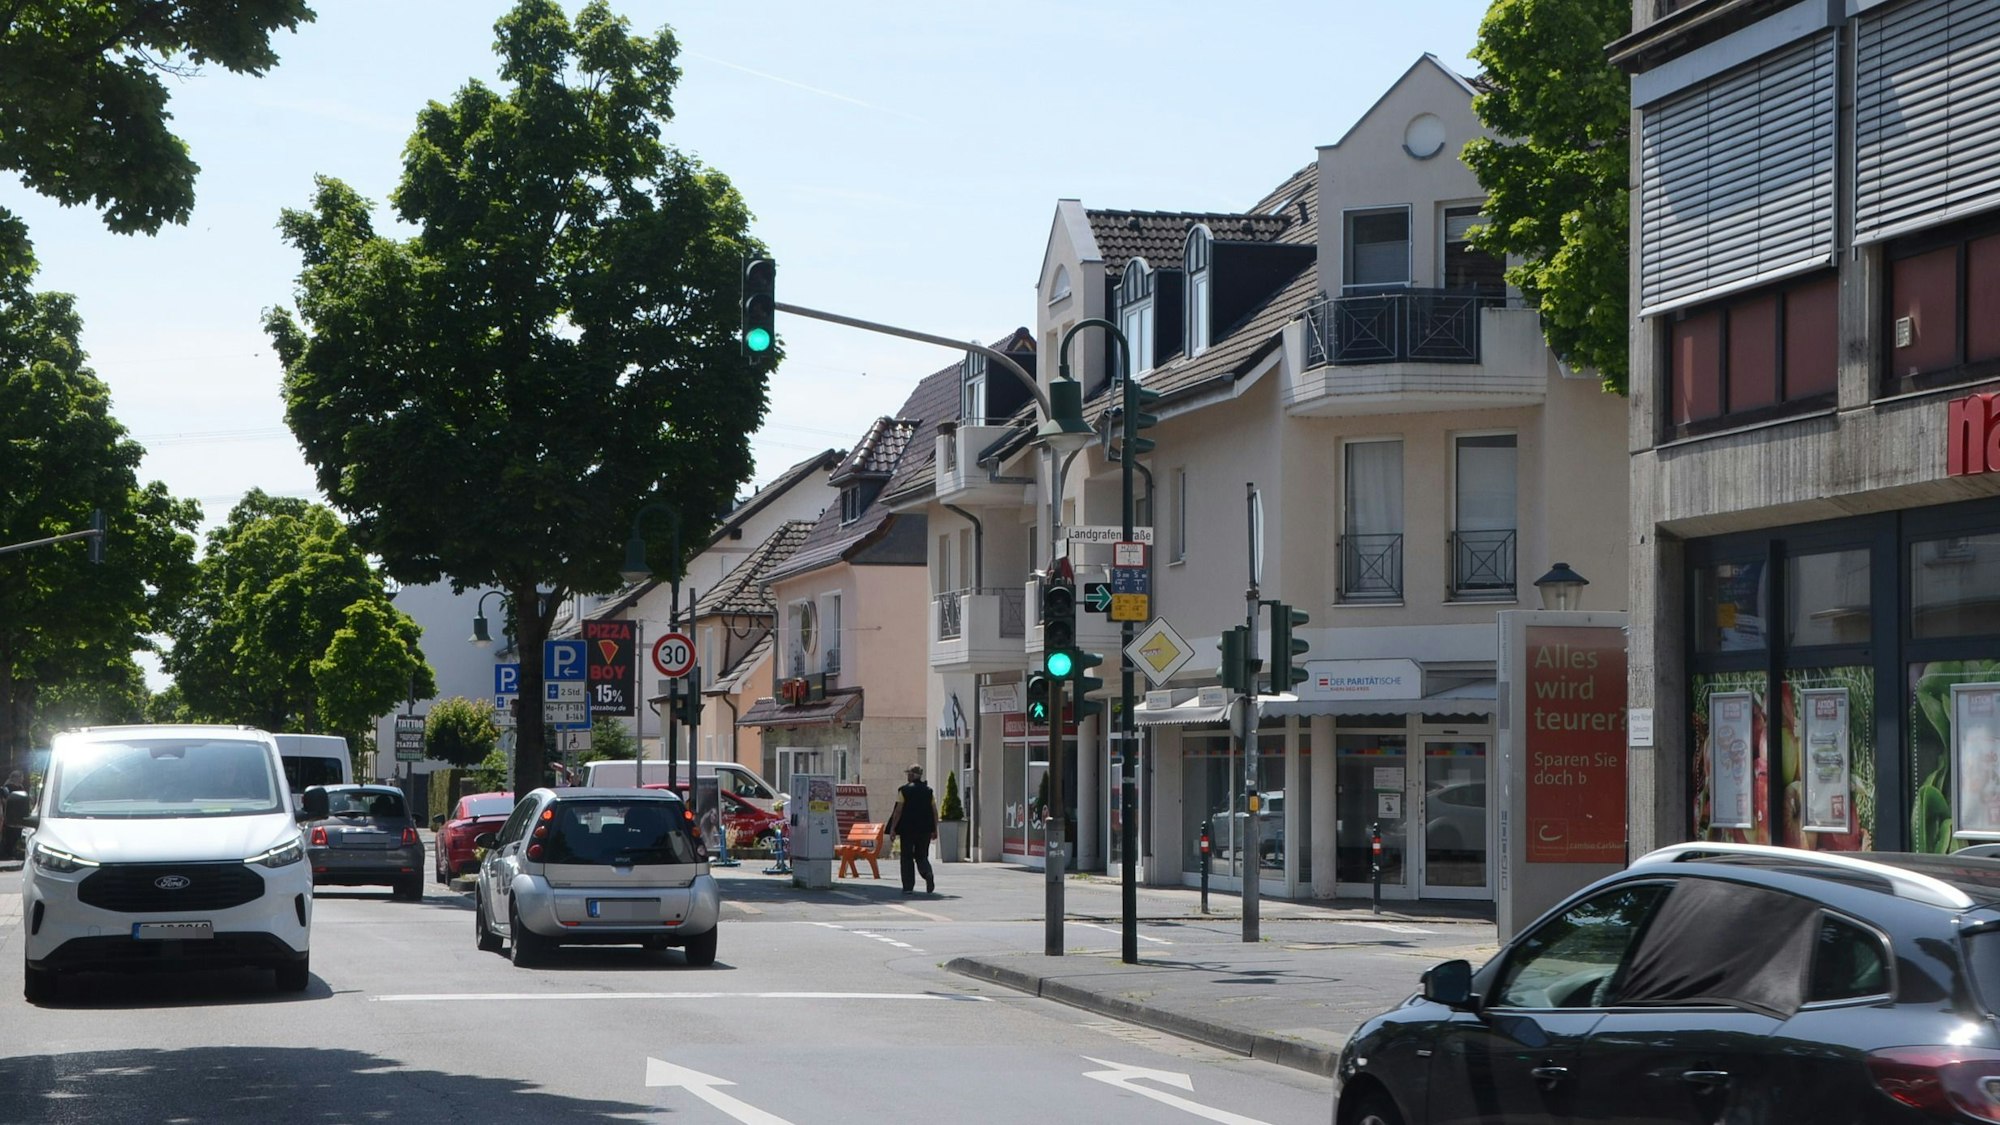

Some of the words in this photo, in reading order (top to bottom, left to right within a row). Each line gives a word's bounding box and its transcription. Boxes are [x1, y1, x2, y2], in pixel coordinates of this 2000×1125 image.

[1068, 528, 1151, 541] Landgrafenaße
[587, 624, 631, 639] PIZZA
[553, 645, 576, 677] P
[661, 645, 686, 665] 30
[1534, 643, 1599, 669] Alles
[501, 667, 516, 692] P
[590, 665, 625, 679] BOY
[1330, 678, 1346, 686] DER
[1347, 675, 1402, 686] PARITÄTISCHE
[561, 688, 566, 696] 2
[596, 684, 623, 703] 15%
[1534, 674, 1594, 700] wird
[397, 719, 424, 729] TATTOO
[1534, 751, 1590, 771] Sparen
[1594, 751, 1618, 767] Sie
[1534, 769, 1573, 786] doch
